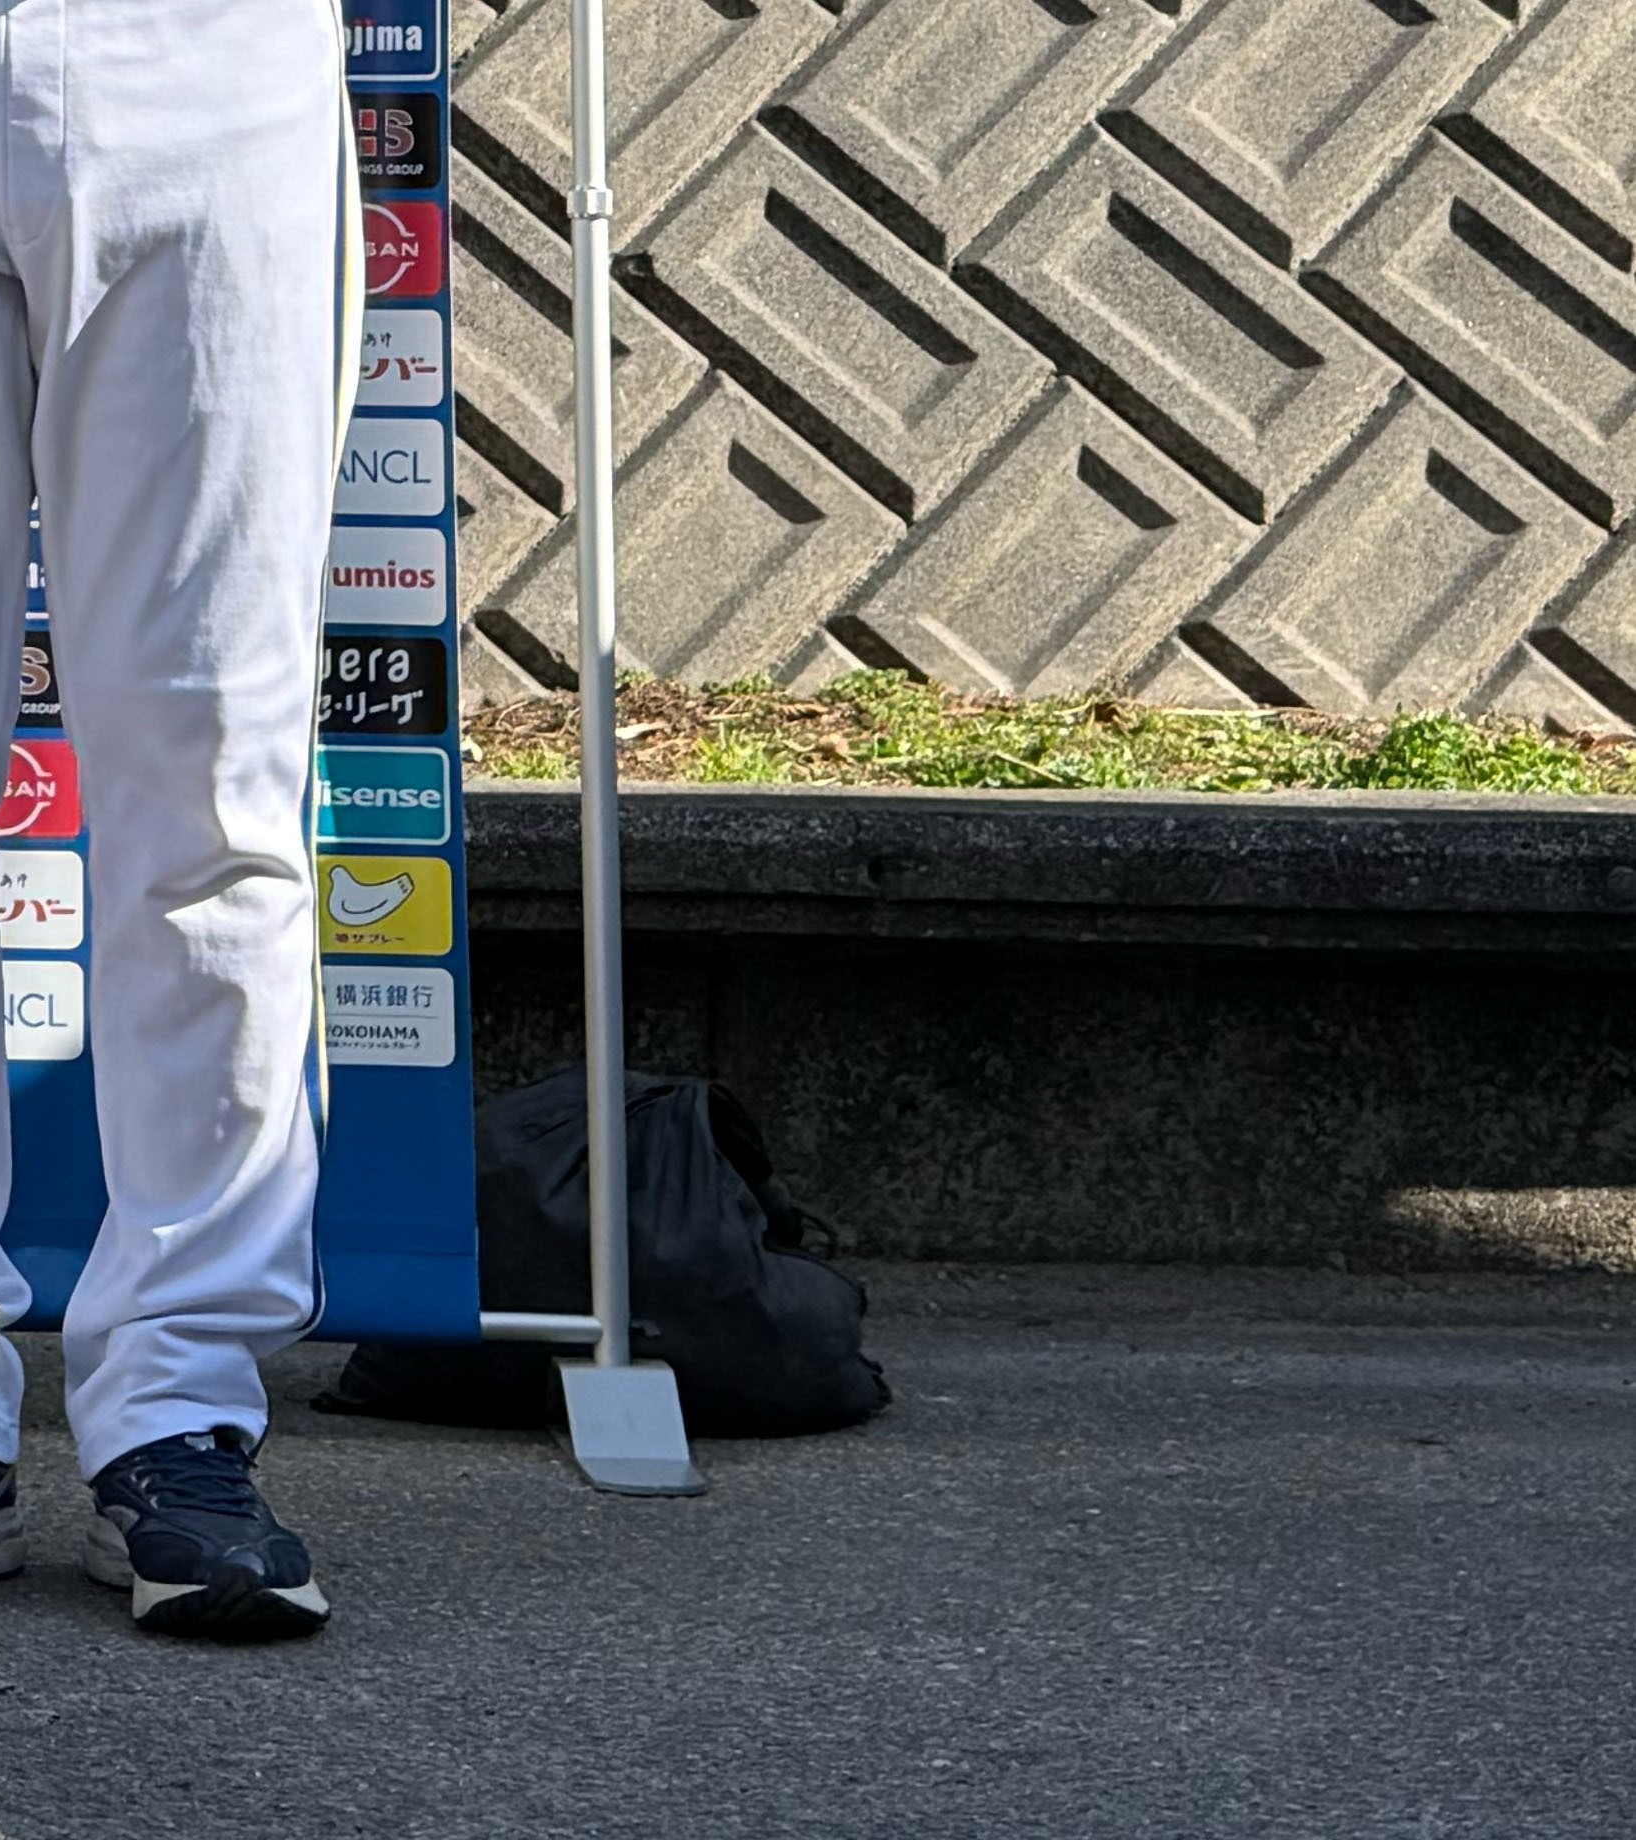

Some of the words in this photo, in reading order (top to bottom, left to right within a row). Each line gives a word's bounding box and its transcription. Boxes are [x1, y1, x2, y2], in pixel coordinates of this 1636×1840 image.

[340, 450, 432, 484] NCL
[333, 561, 436, 589] umios
[320, 780, 442, 808] isense
[336, 984, 433, 1008] 横浜銀行
